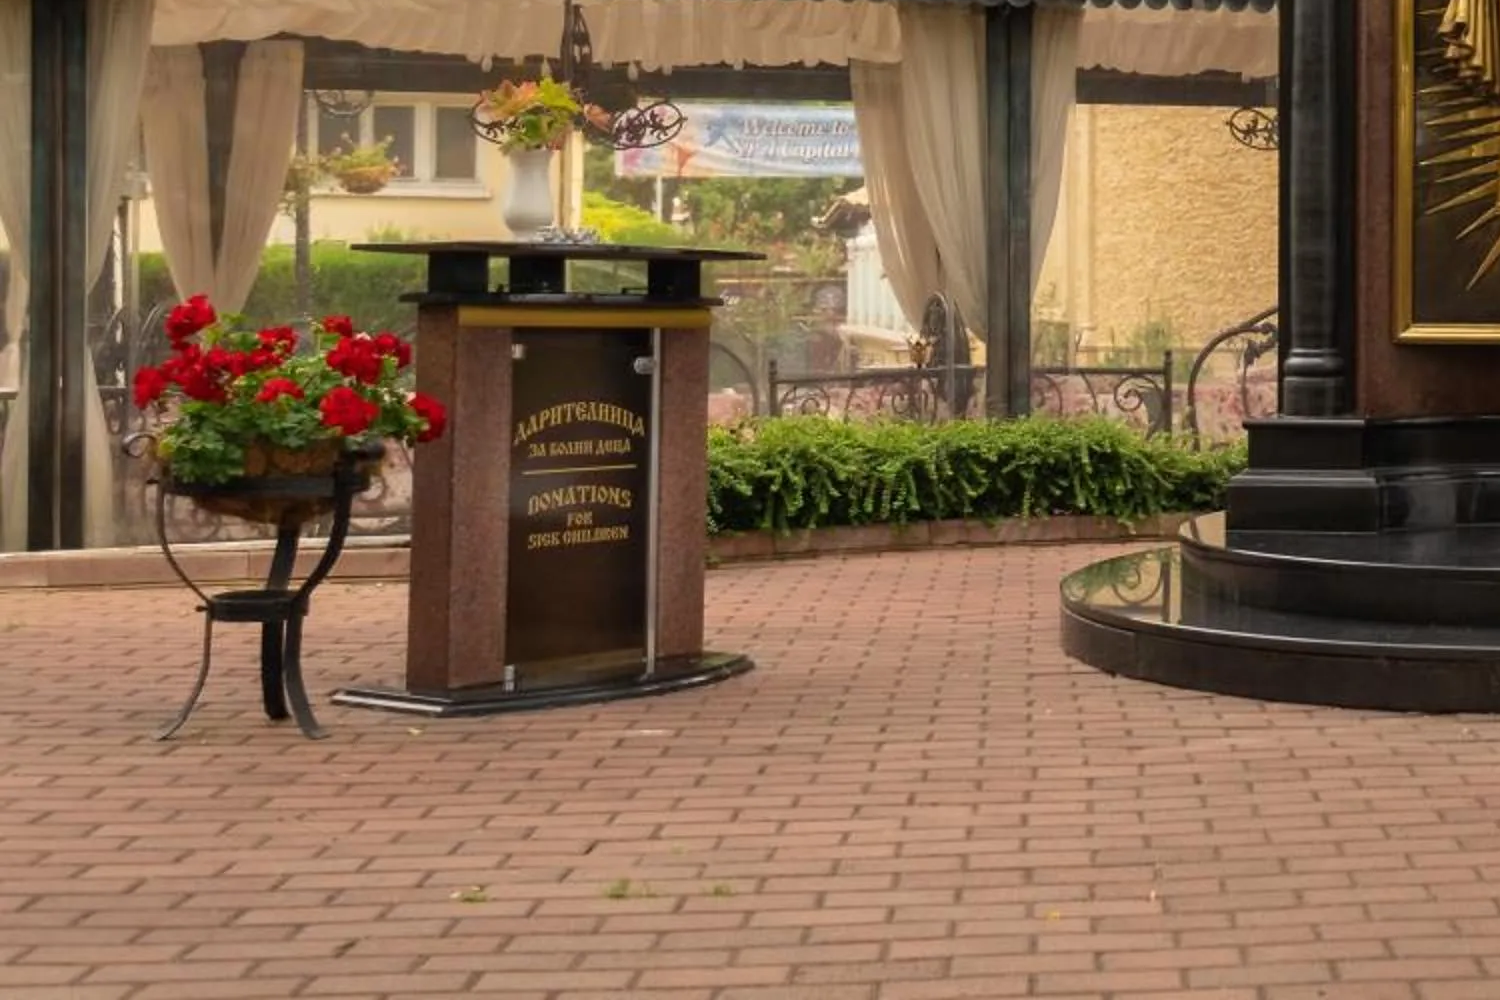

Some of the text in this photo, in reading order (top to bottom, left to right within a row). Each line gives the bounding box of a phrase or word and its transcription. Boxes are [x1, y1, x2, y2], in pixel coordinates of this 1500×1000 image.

[741, 116, 830, 137] Welcome
[513, 400, 646, 446] ДАРИТЕЛНИЦА
[527, 484, 632, 516] DONATIONS
[566, 510, 593, 527] FOR
[527, 524, 630, 550] SICK CHILDREN
